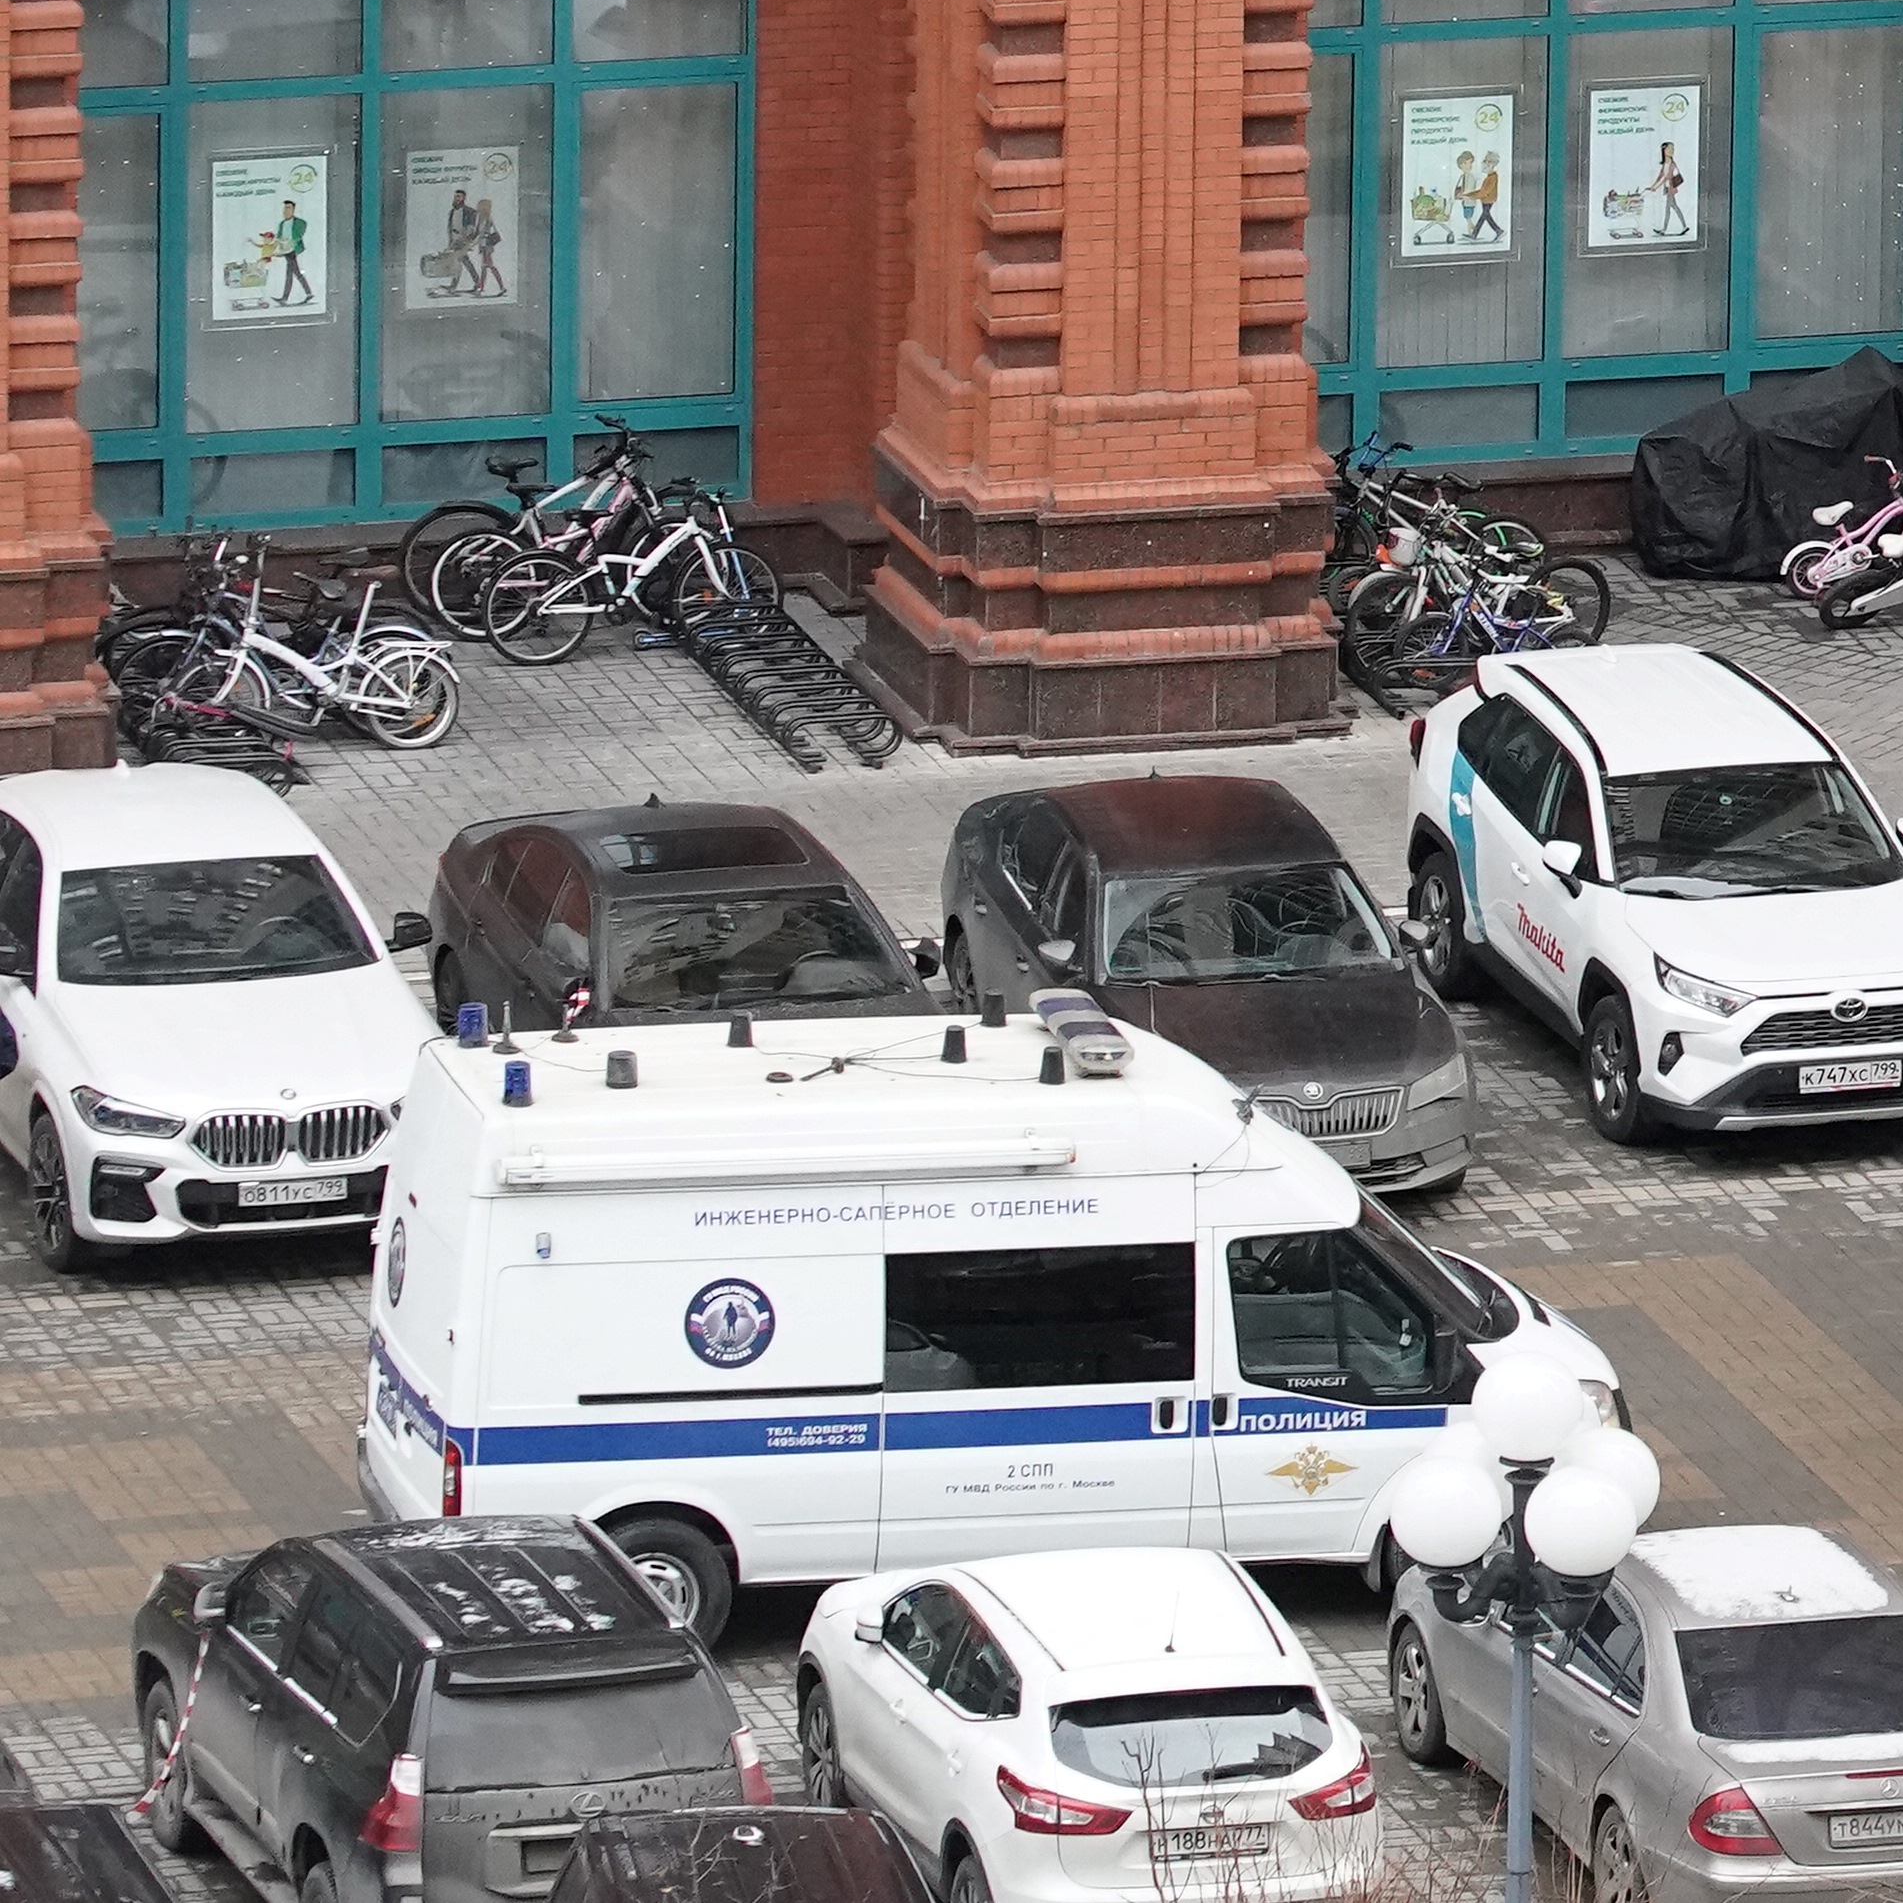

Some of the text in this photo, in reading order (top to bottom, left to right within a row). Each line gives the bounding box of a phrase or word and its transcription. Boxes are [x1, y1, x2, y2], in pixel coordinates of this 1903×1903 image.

[1665, 100, 1685, 114] 24
[1479, 111, 1499, 124] 24
[694, 1197, 1099, 1227] ИНЖЕНЕРНО-САПЁРНОЕ ОТДЕЛЕНИЕ
[1286, 1376, 1348, 1388] TRANSIT
[1240, 1410, 1367, 1432] ПОЛИЦИЯ
[766, 1423, 868, 1437] ТЕЛ. ДОВЕРИЯ
[1008, 1463, 1054, 1478] 2 СПП
[945, 1485, 959, 1494] ГУ
[963, 1483, 991, 1494] МВД
[995, 1481, 1036, 1492] России
[1073, 1479, 1115, 1489] Москве
